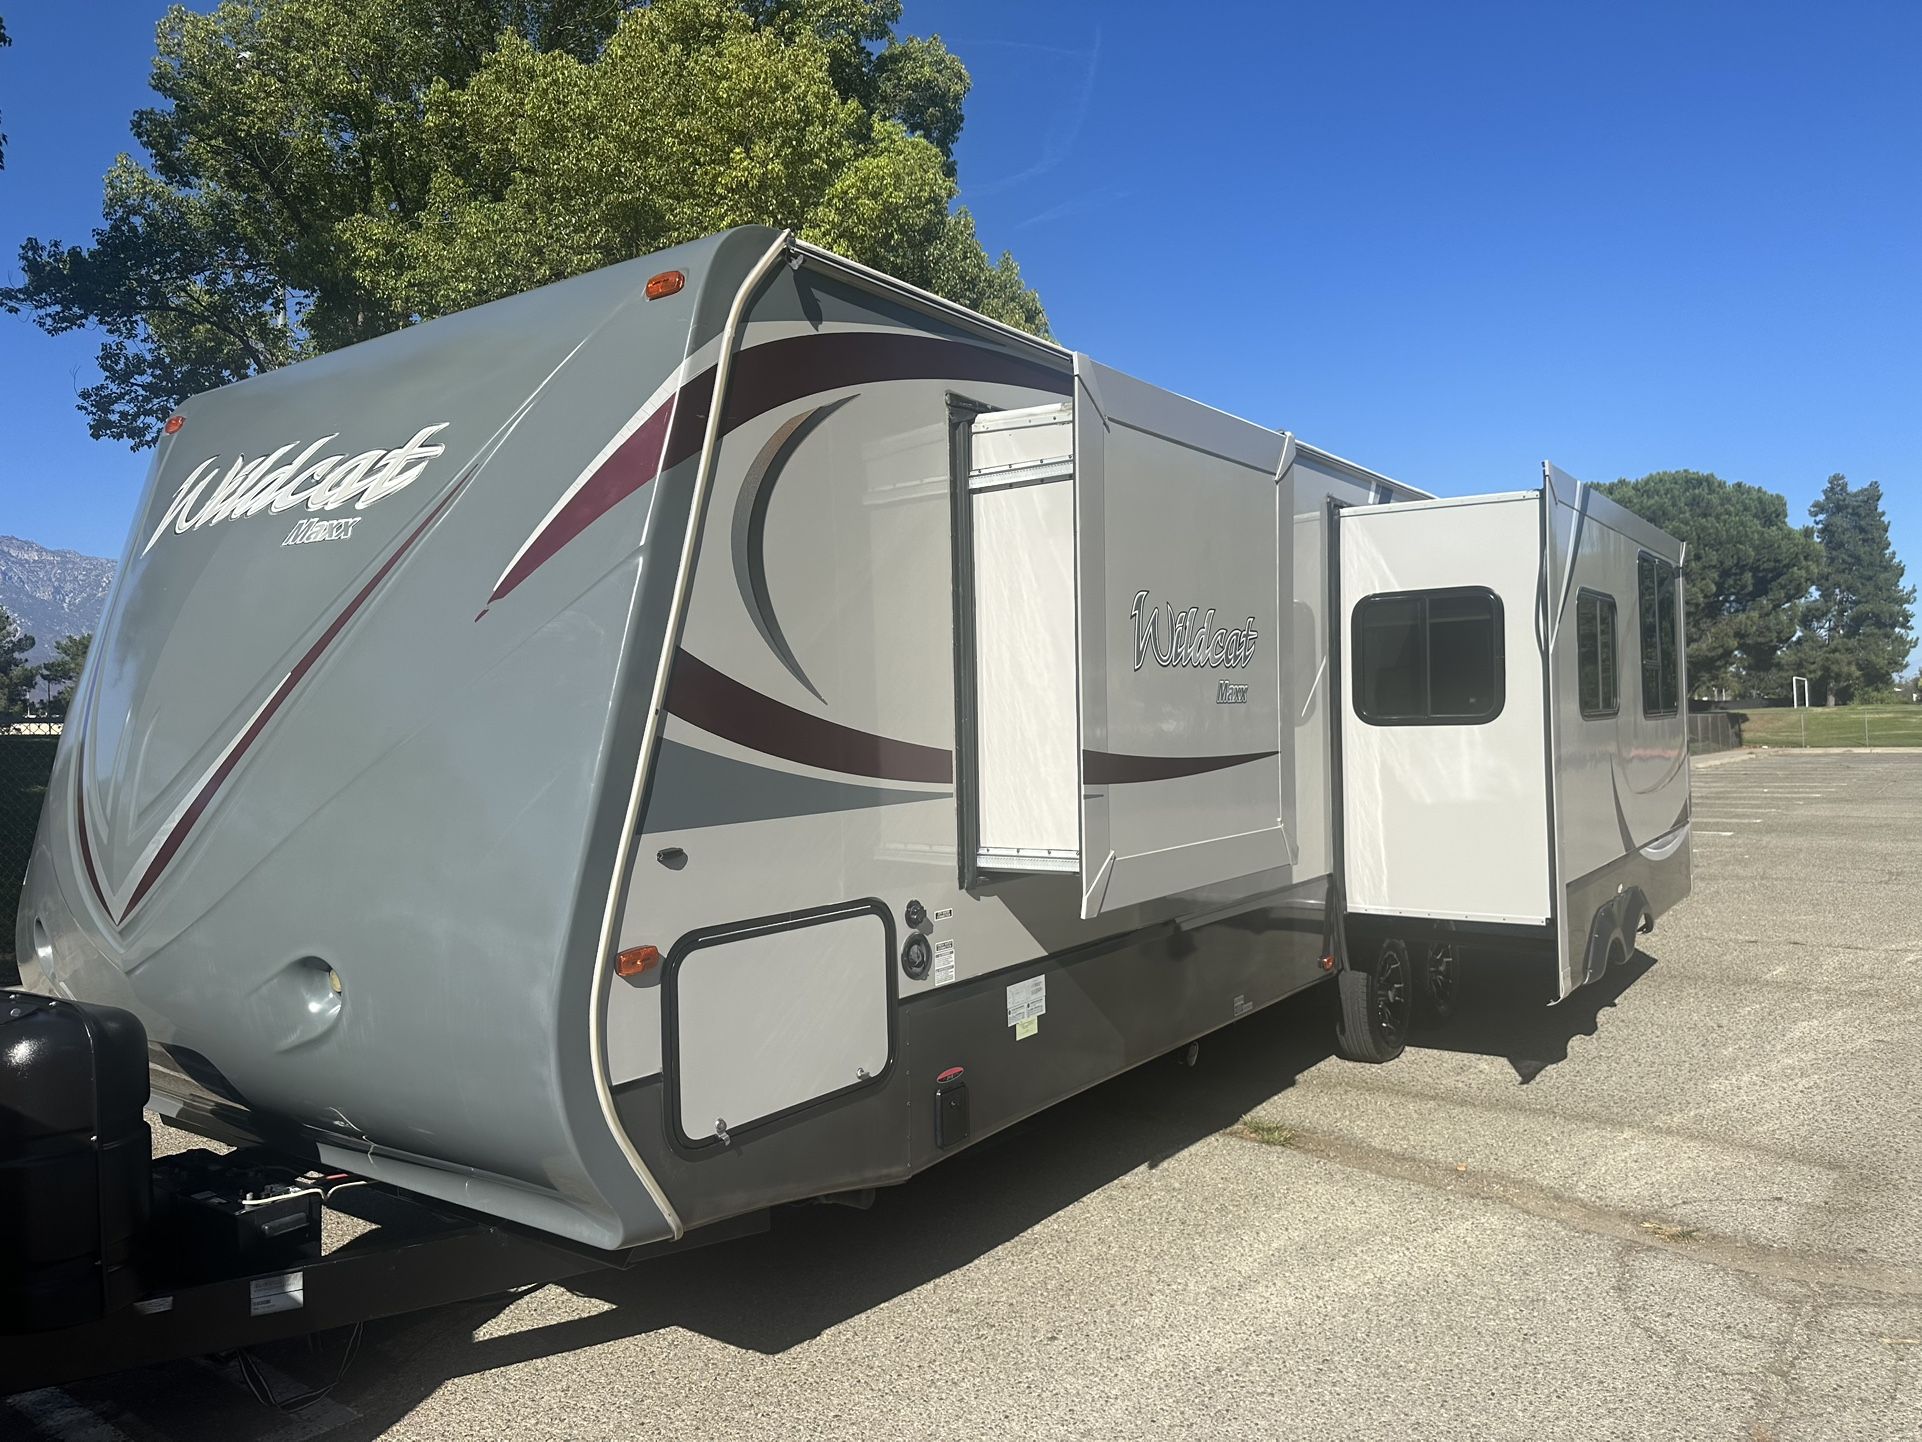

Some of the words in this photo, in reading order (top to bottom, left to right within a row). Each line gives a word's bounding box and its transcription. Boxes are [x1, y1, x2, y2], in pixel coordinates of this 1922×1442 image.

[141, 422, 450, 559] Wildcat
[281, 516, 361, 546] Maxx
[1130, 589, 1258, 672] Wildcat
[1216, 679, 1248, 704] Maxx
